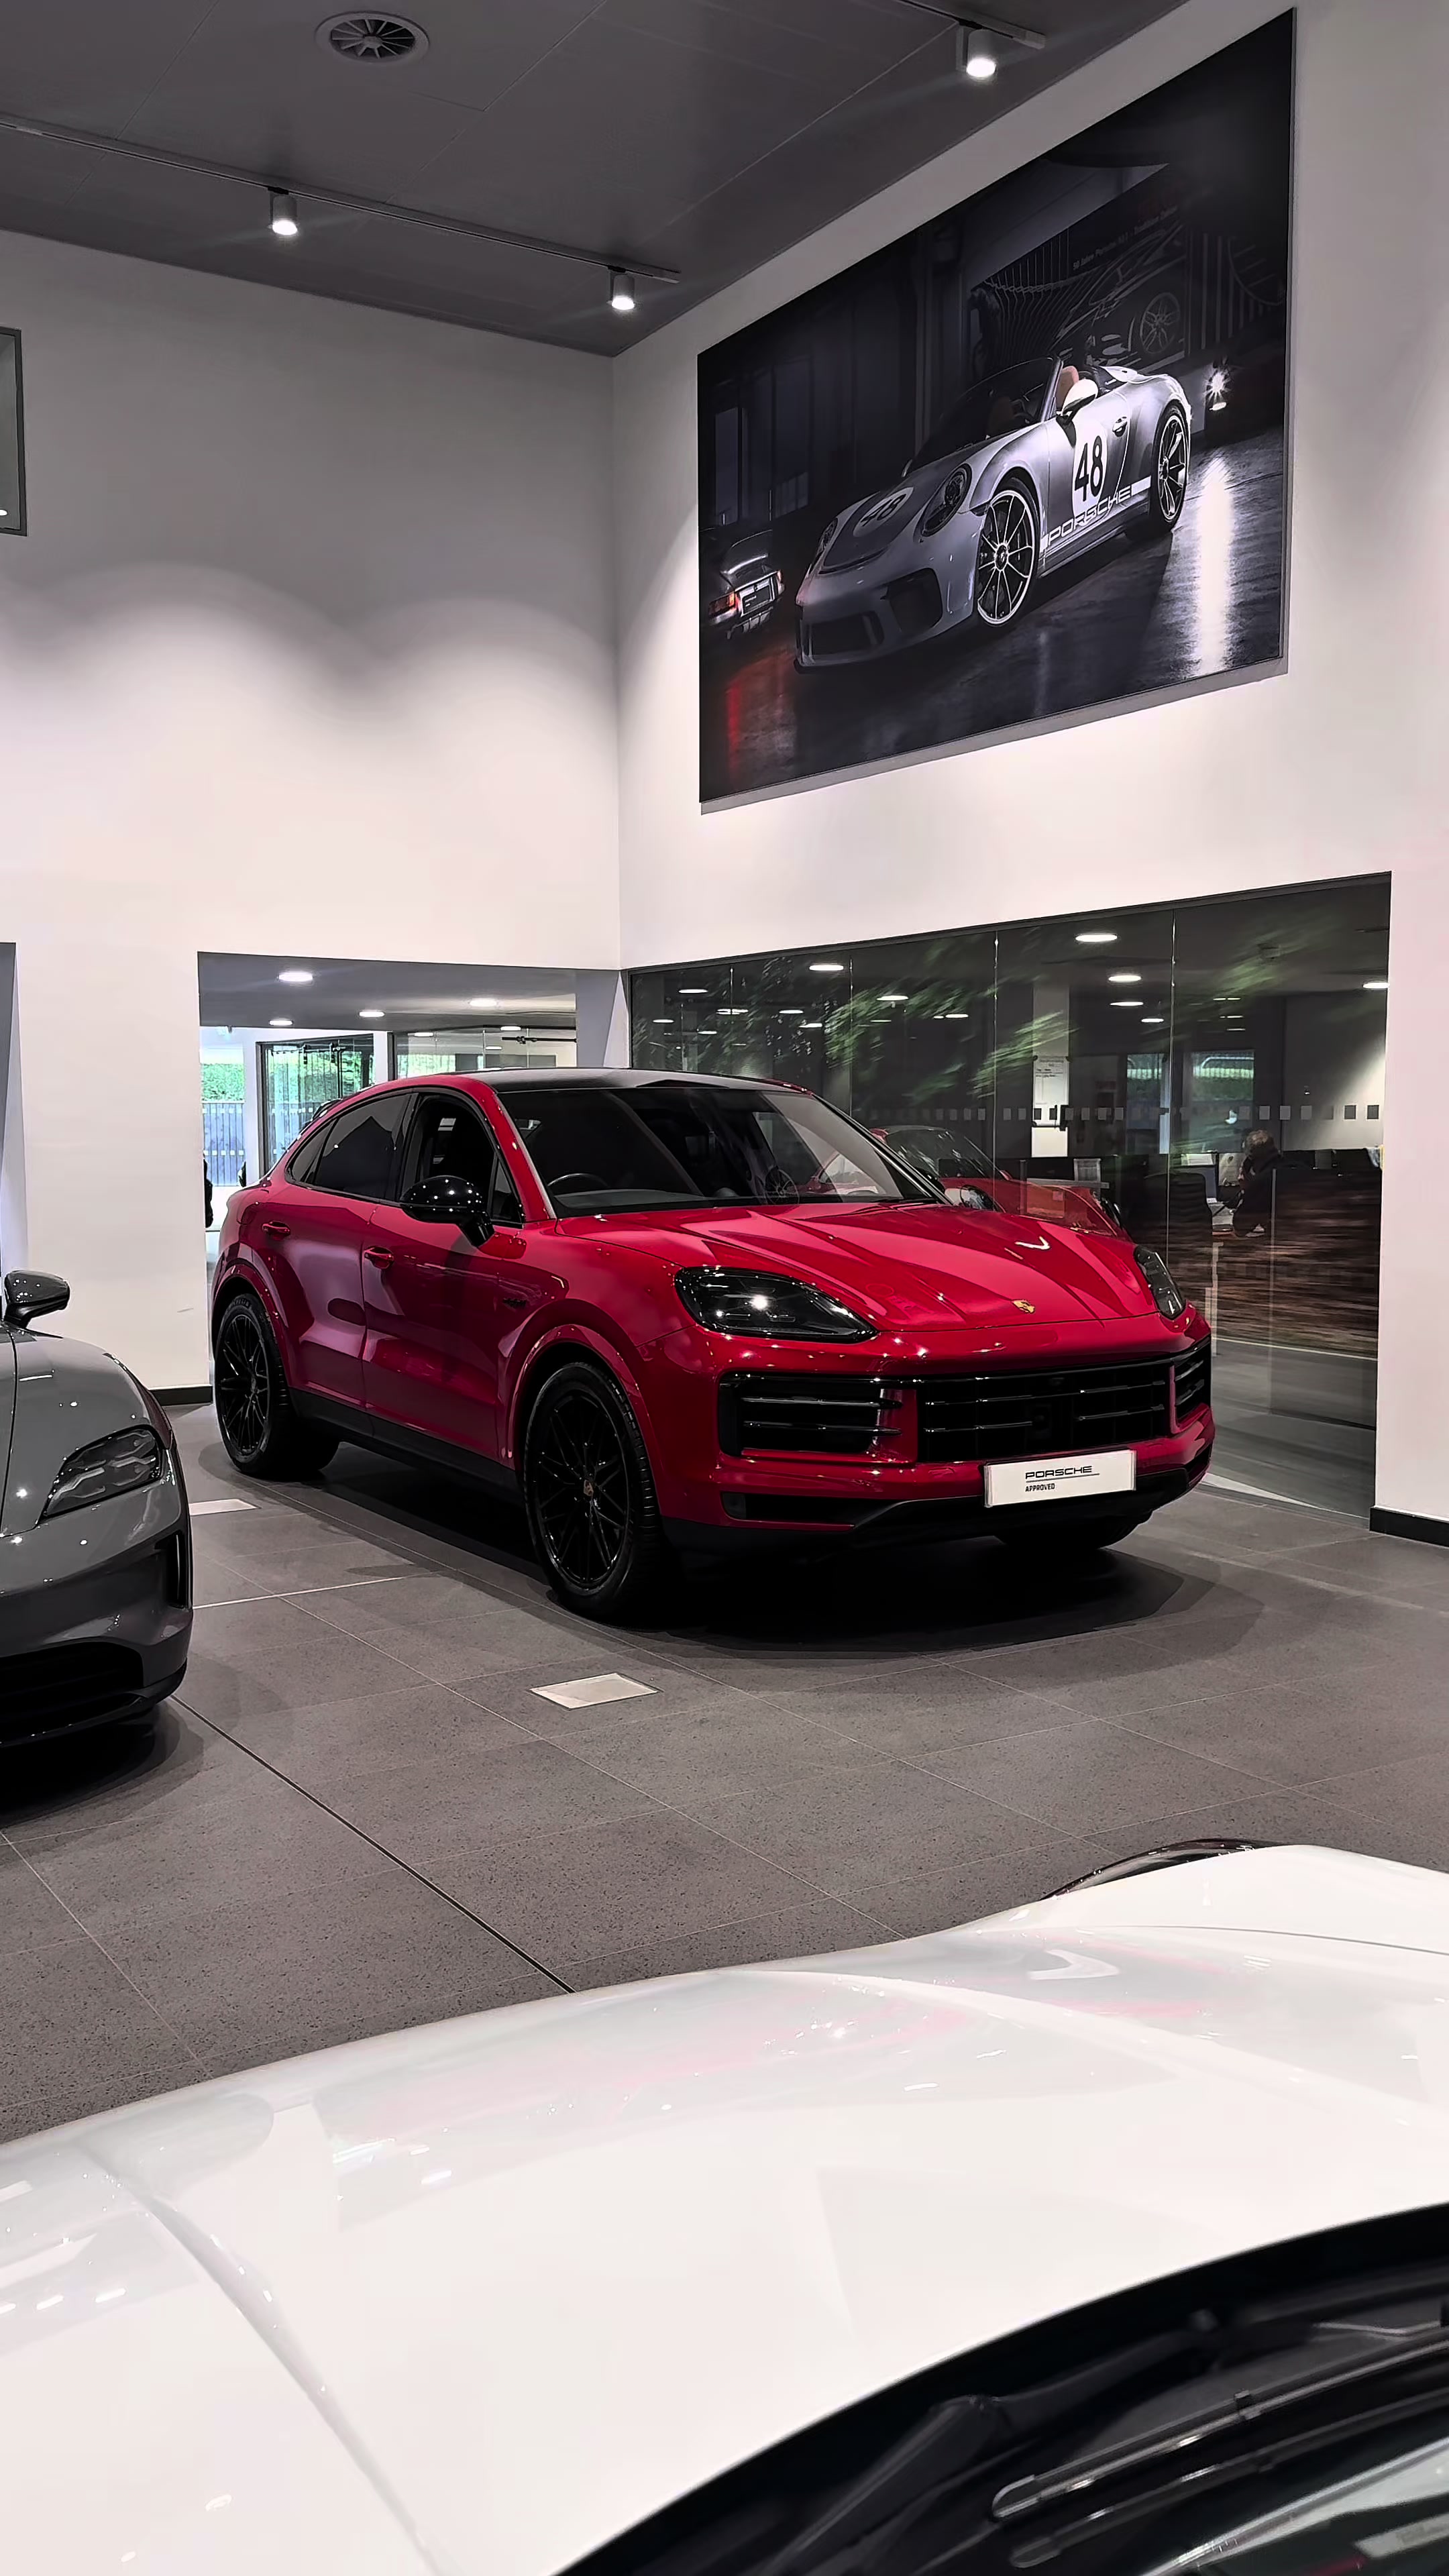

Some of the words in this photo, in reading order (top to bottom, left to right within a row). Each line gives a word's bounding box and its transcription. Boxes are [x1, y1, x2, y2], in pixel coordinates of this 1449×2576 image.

[1075, 435, 1104, 502] 48
[860, 493, 907, 527] 48
[1049, 485, 1131, 546] PORSCHE
[1025, 1466, 1093, 1480] PORSCHE
[1025, 1483, 1055, 1492] APPROVED
